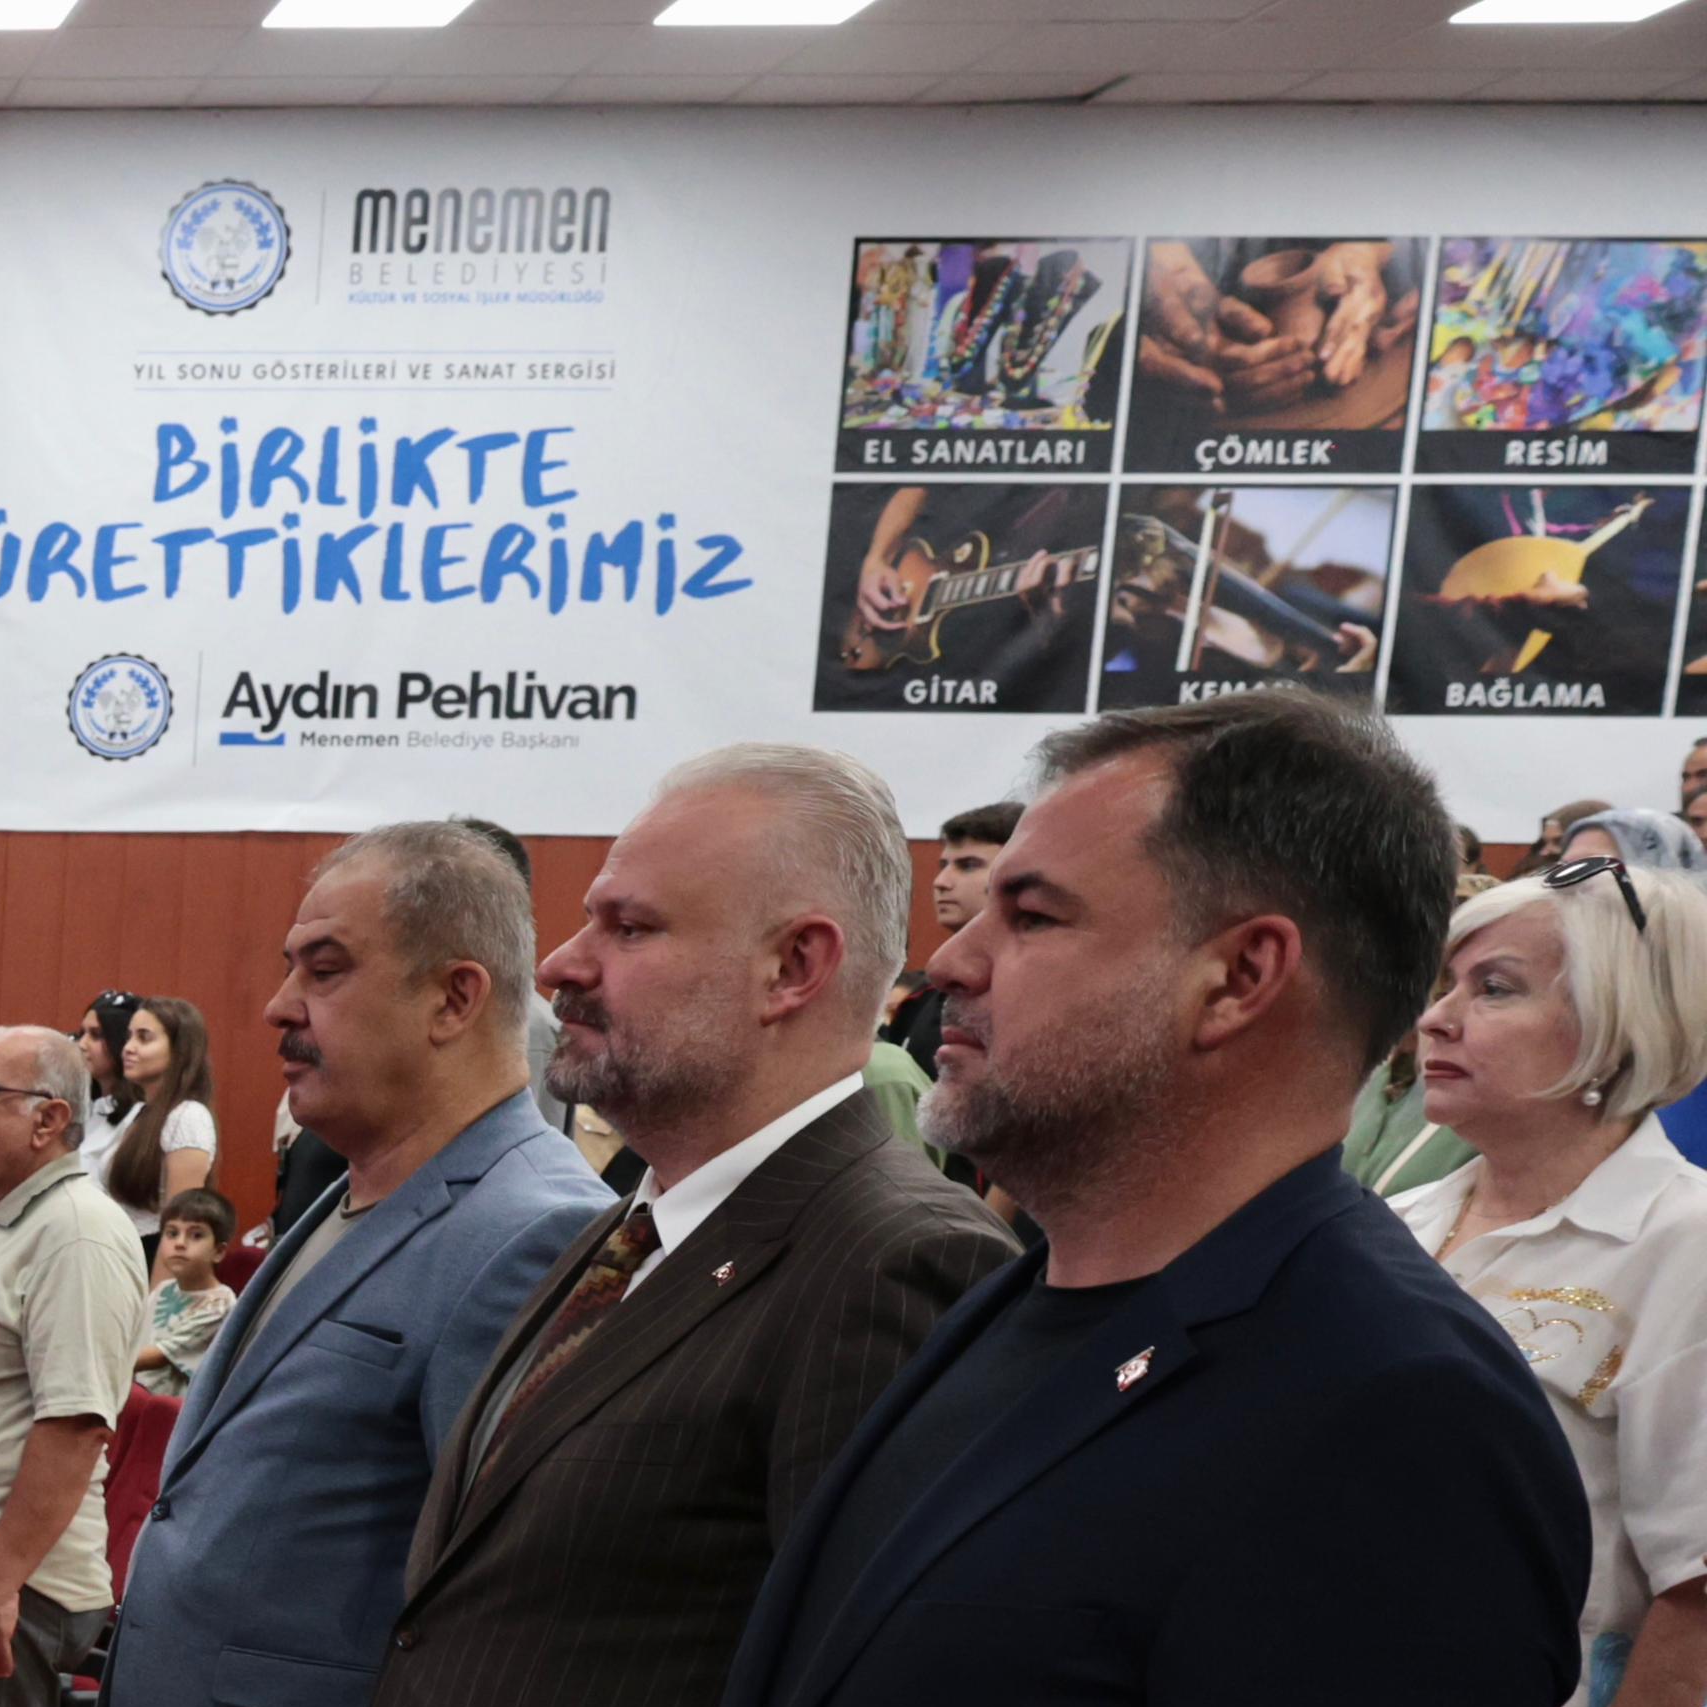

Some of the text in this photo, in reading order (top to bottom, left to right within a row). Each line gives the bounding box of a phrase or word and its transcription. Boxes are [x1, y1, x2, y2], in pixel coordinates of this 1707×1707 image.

[351, 187, 611, 254] menemen
[348, 257, 608, 286] BELEDİYESİ
[133, 360, 617, 381] YIL SONU GÖSTERİLERİ VE SANAT SERGİSİ
[863, 438, 1086, 465] EL SANATLARI
[1195, 438, 1333, 471] ÇÖMLEK
[1504, 435, 1609, 466] RESİM
[154, 416, 578, 518] BİRLİKTE
[221, 671, 379, 733] Aydın
[397, 671, 637, 721] Pehlivan
[902, 675, 998, 705] GİTAR
[1178, 680, 1296, 705] KEM
[1444, 677, 1606, 708] BAĞLAMA
[300, 731, 580, 751] Menemen Belediye Başkanı
